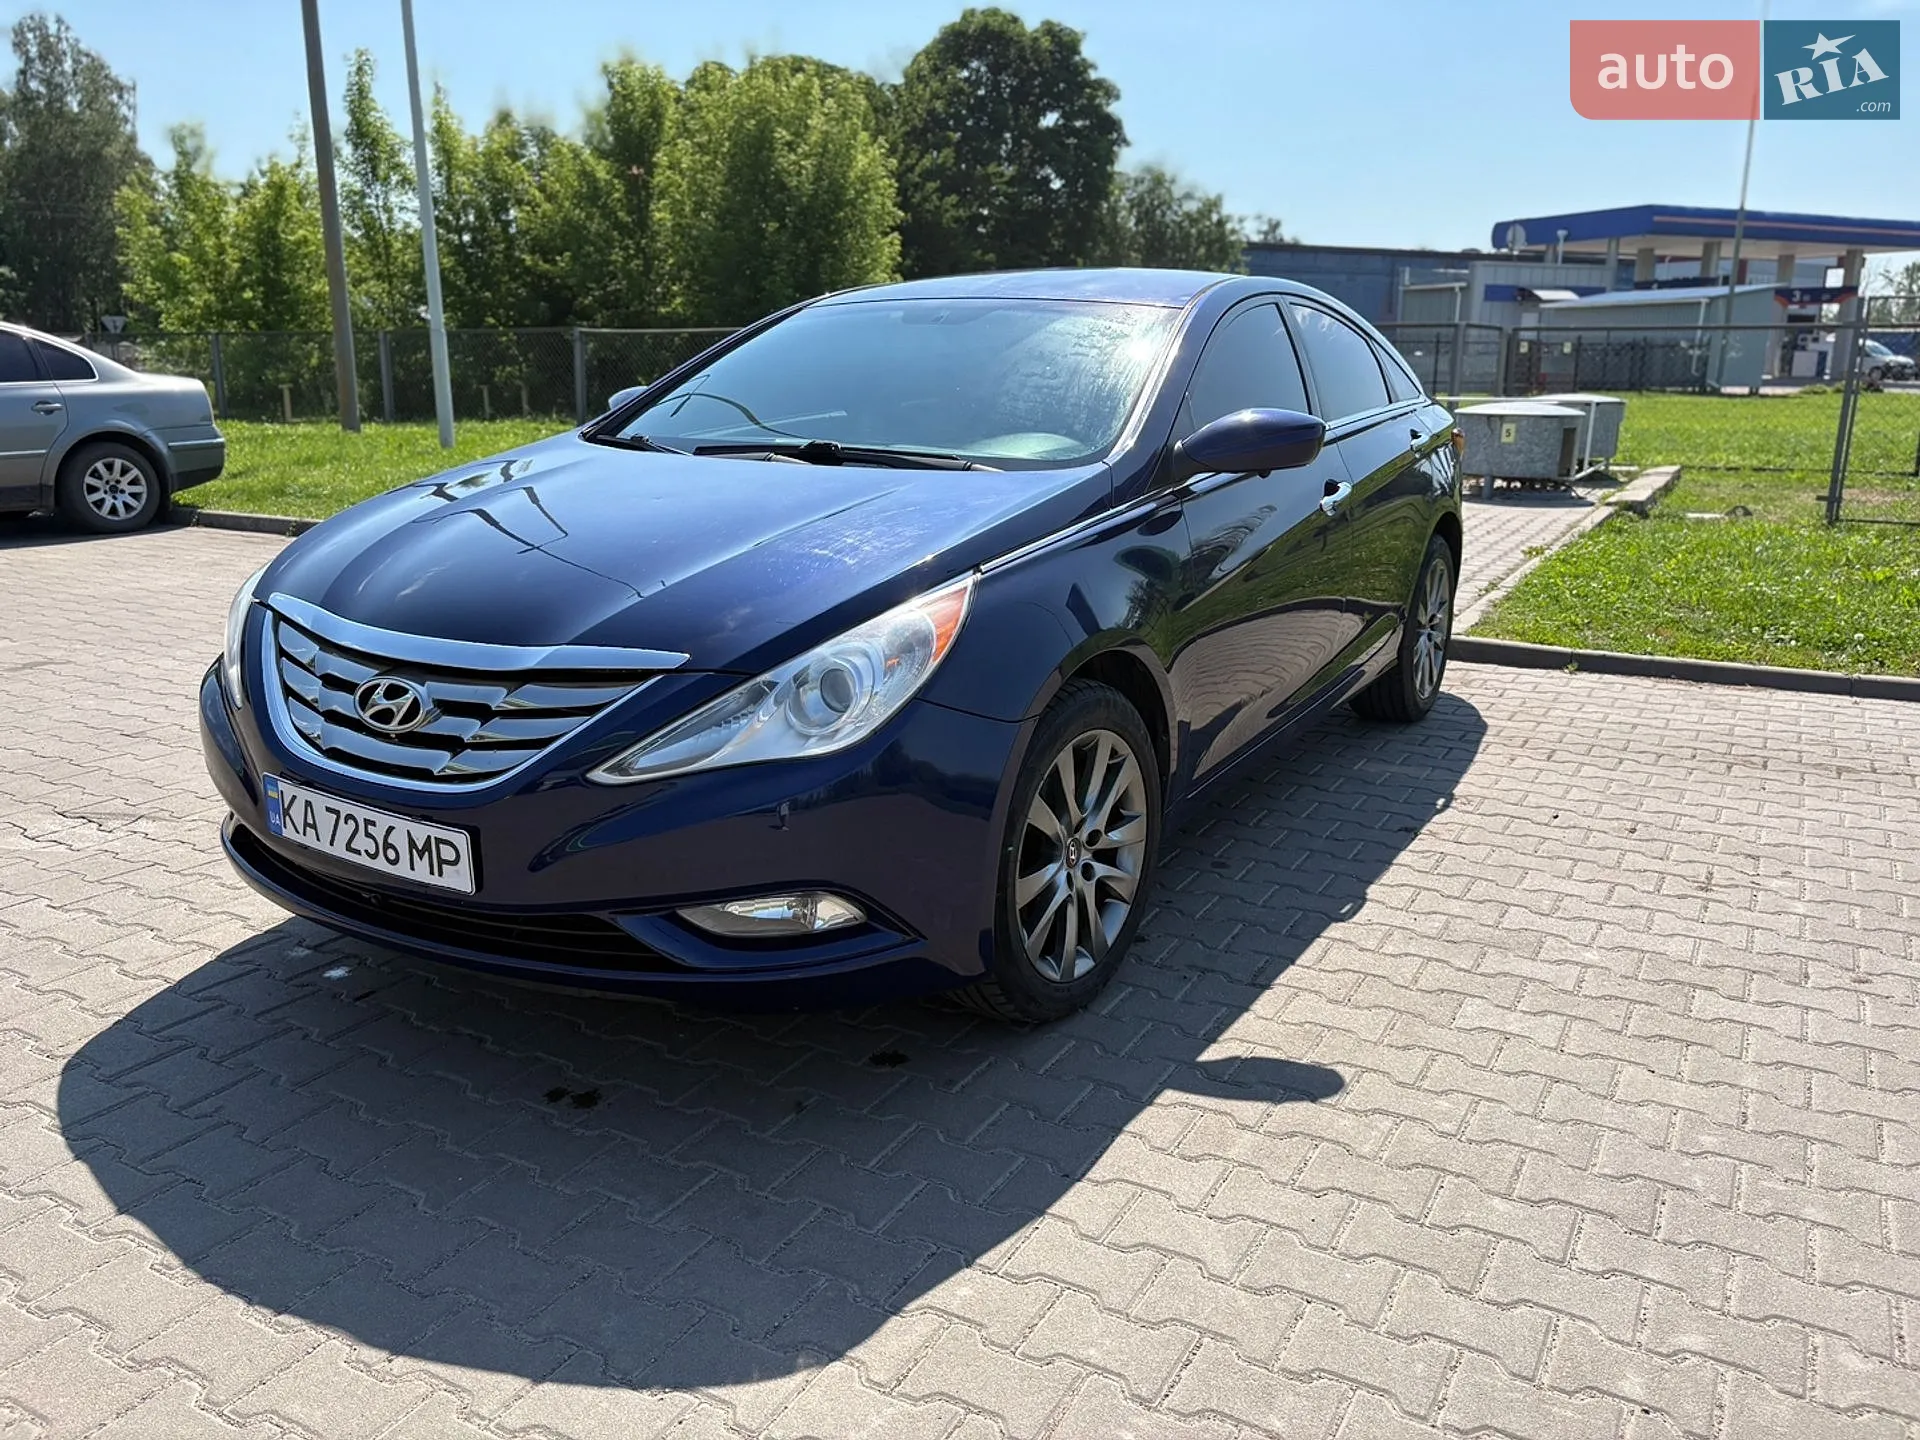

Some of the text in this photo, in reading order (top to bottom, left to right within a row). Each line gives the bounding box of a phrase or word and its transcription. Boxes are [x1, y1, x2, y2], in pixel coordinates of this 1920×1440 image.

[1505, 428, 1512, 438] 5
[269, 811, 280, 825] UA
[281, 790, 461, 877] KA 7256 MP
